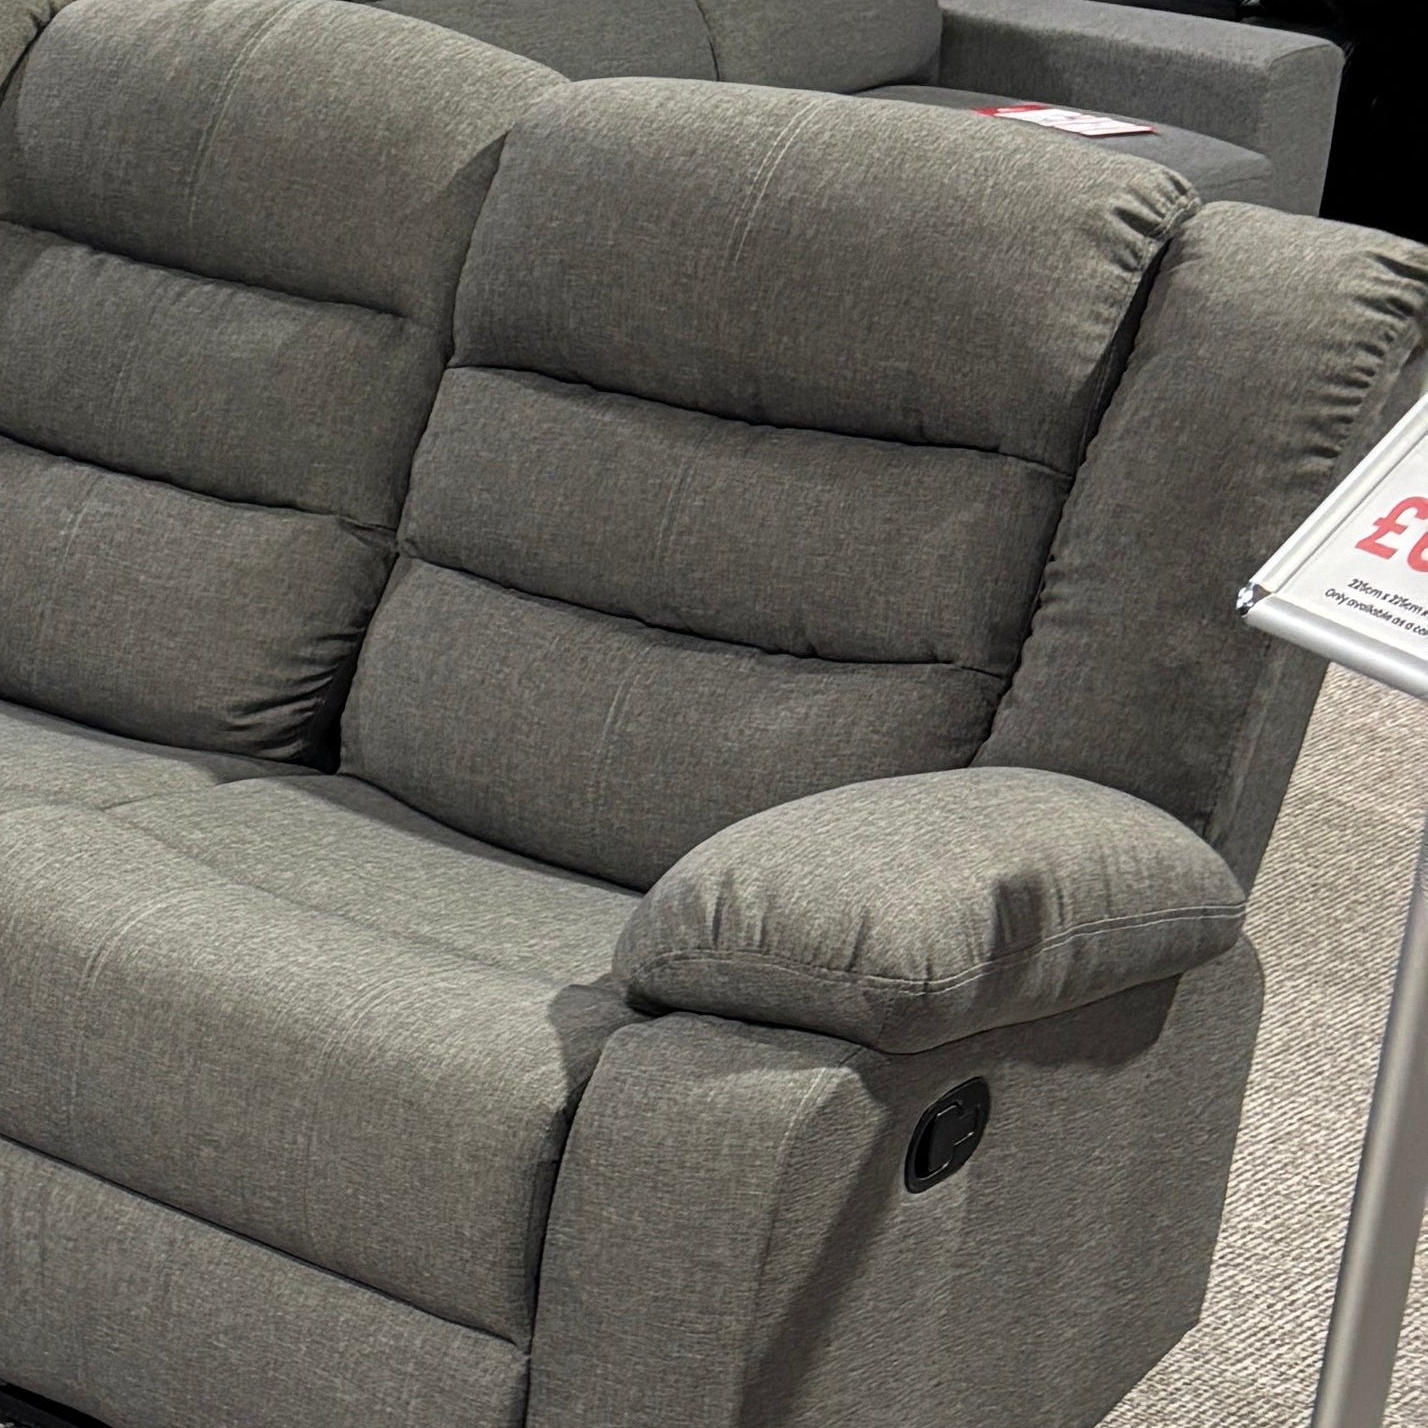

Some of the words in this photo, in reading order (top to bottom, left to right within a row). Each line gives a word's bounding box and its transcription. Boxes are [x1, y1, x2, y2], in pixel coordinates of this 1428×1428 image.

[1324, 588, 1349, 605] Only
[1346, 597, 1394, 621] available
[1391, 616, 1406, 628] as
[1347, 578, 1383, 601] 225cm
[1388, 593, 1423, 615] 225cm
